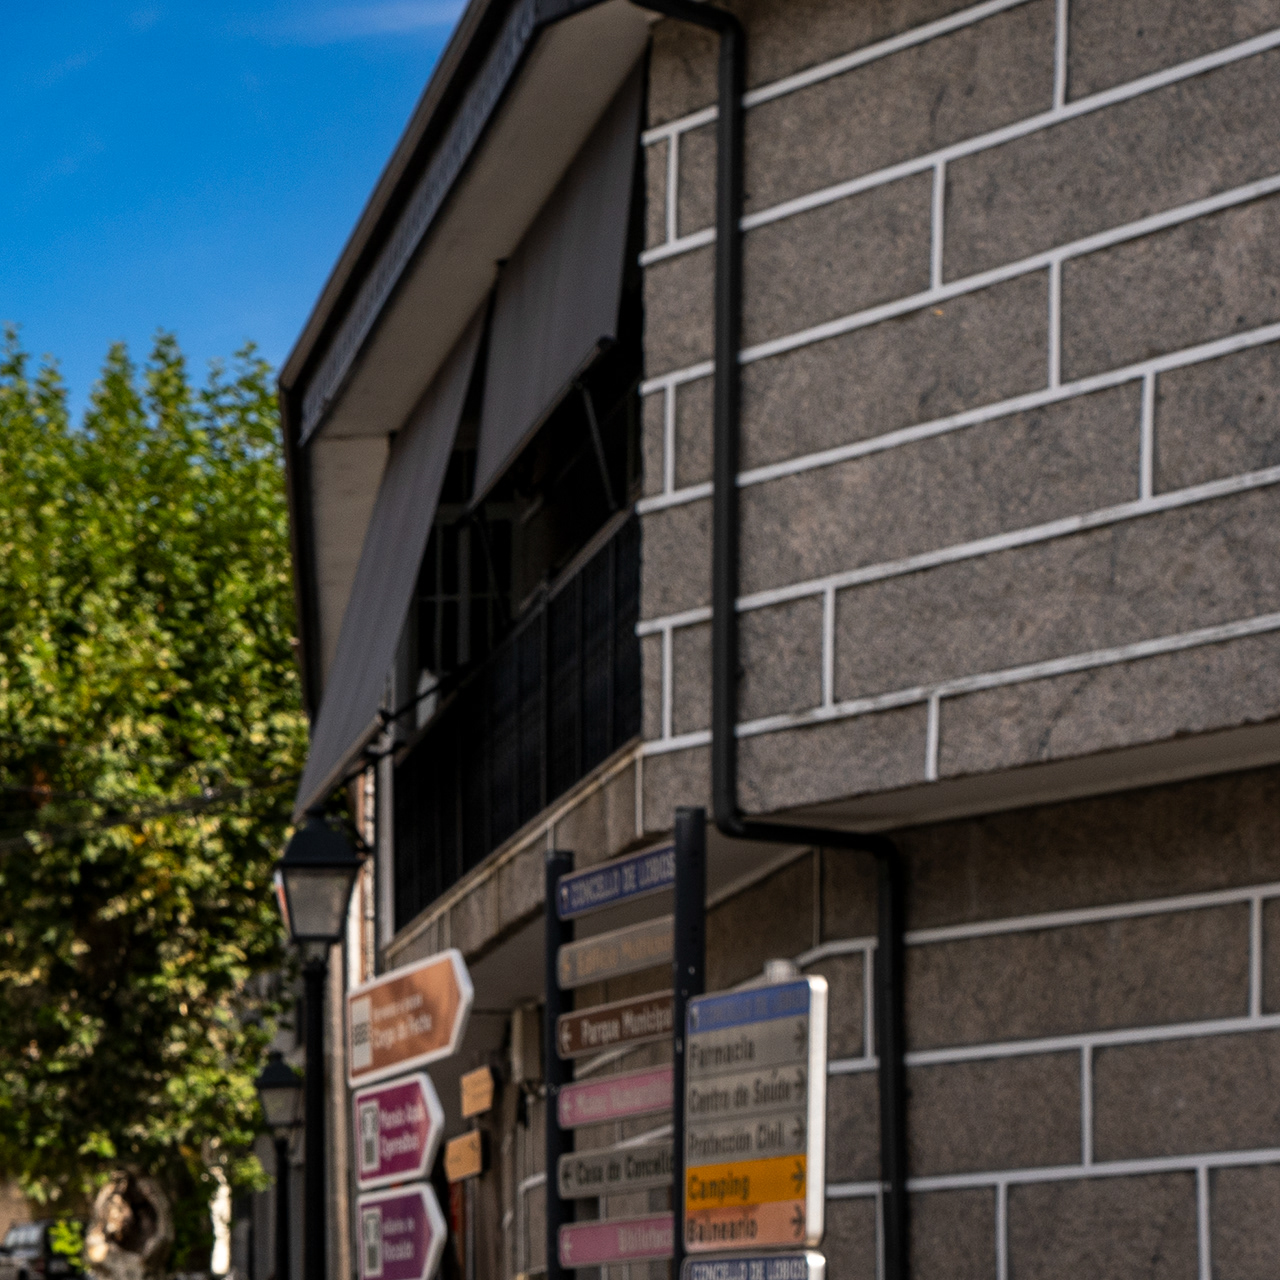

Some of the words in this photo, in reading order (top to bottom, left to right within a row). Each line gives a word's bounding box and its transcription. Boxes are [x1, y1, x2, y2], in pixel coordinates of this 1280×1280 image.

[581, 1016, 620, 1046] Parque
[690, 1038, 756, 1068] Farmacia
[690, 1084, 730, 1113] Centro
[732, 1080, 748, 1105] de
[576, 1160, 601, 1184] Casa
[688, 1172, 750, 1206] Camping
[687, 1210, 758, 1243] Balneario
[750, 1257, 766, 1280] DE
